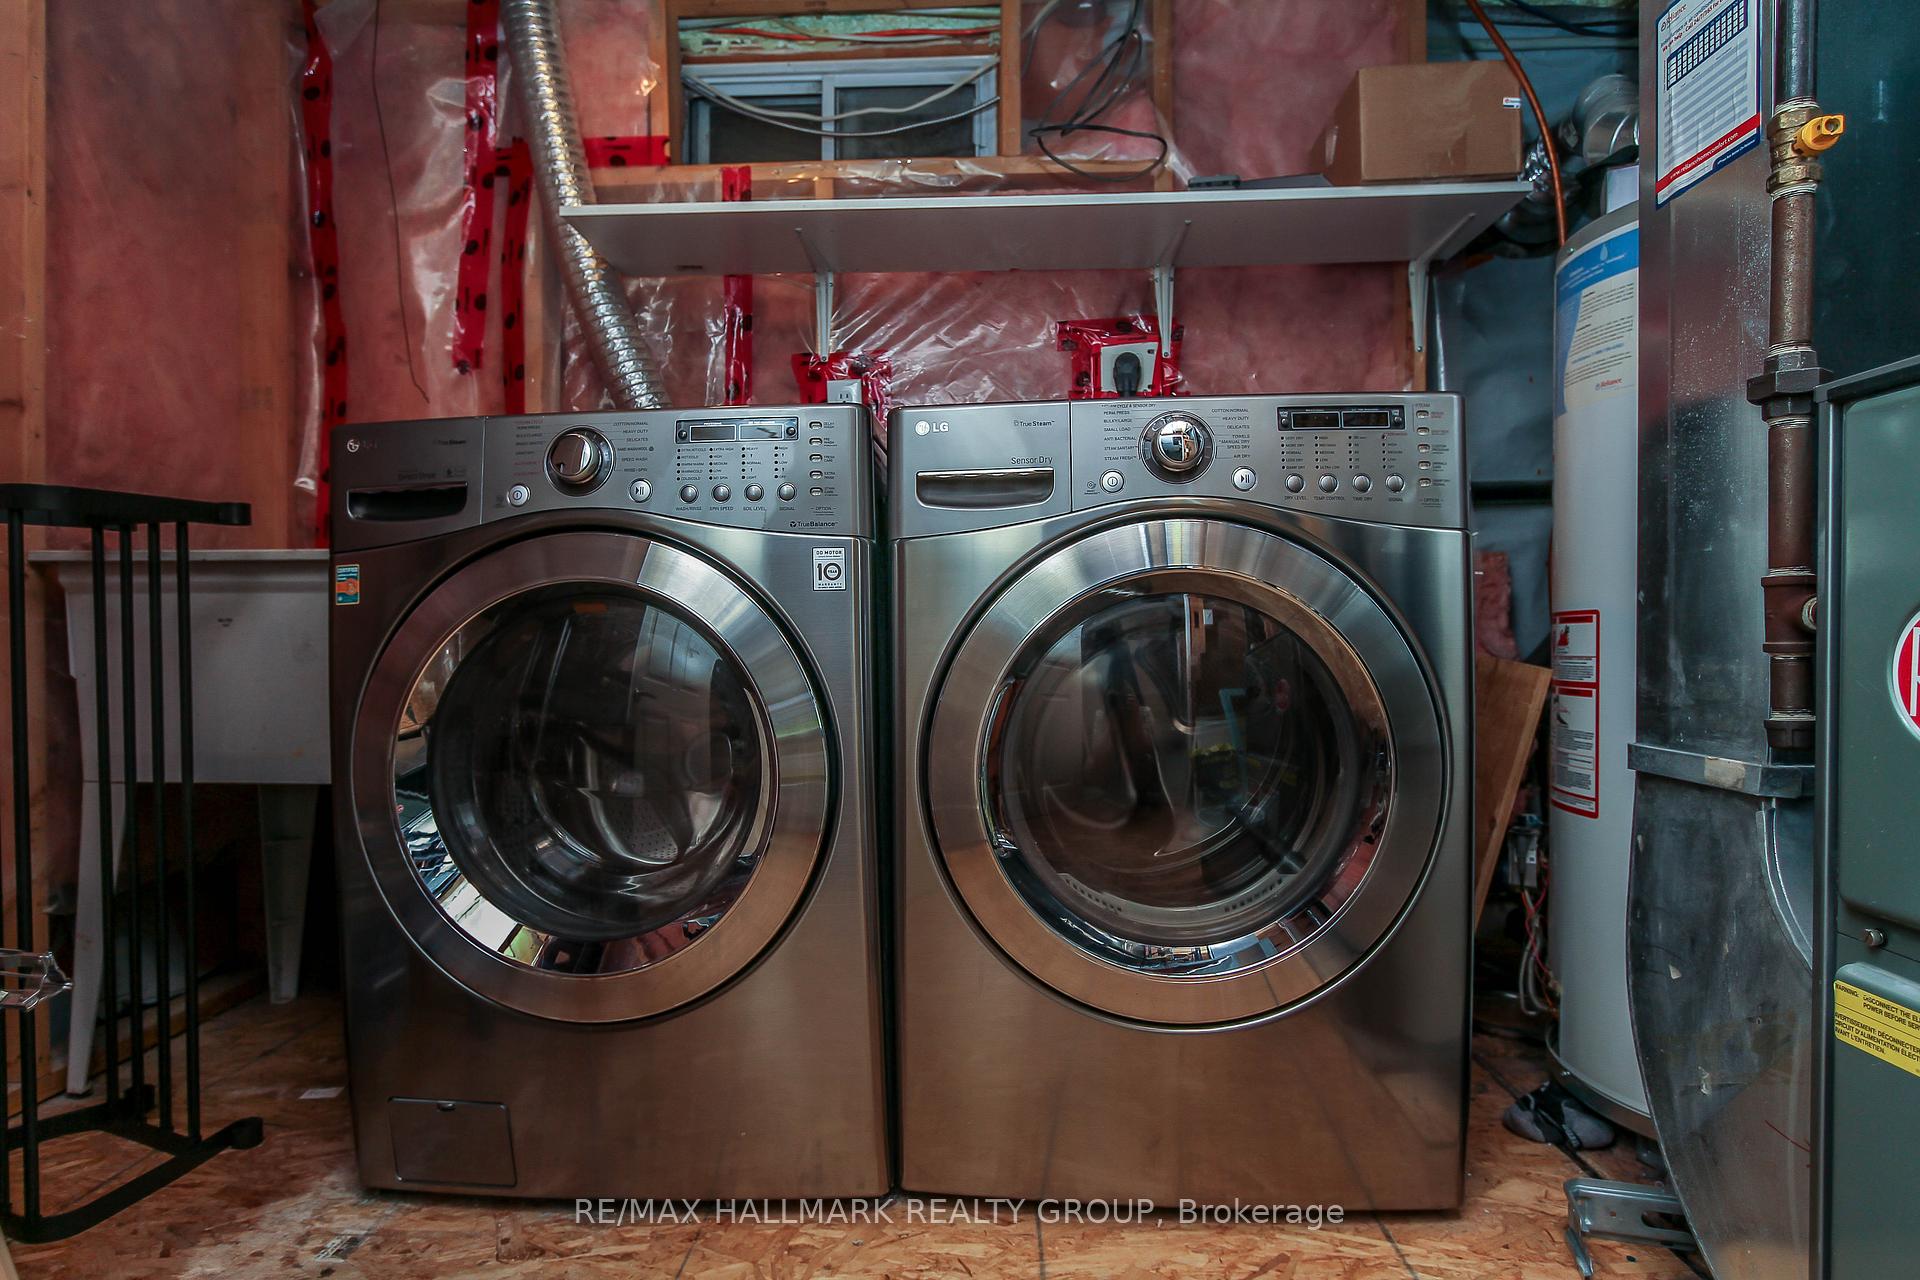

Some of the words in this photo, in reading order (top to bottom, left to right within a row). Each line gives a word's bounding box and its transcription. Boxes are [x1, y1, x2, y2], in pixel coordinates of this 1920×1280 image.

[932, 422, 949, 432] LG
[1011, 456, 1037, 464] Sensor
[1039, 456, 1053, 465] Dry
[817, 563, 842, 580] 10
[1863, 995, 1899, 1013] DISCONNECT
[1900, 1010, 1911, 1019] THE
[1863, 1002, 1883, 1015] POWER
[1884, 1011, 1907, 1025] BEFORE
